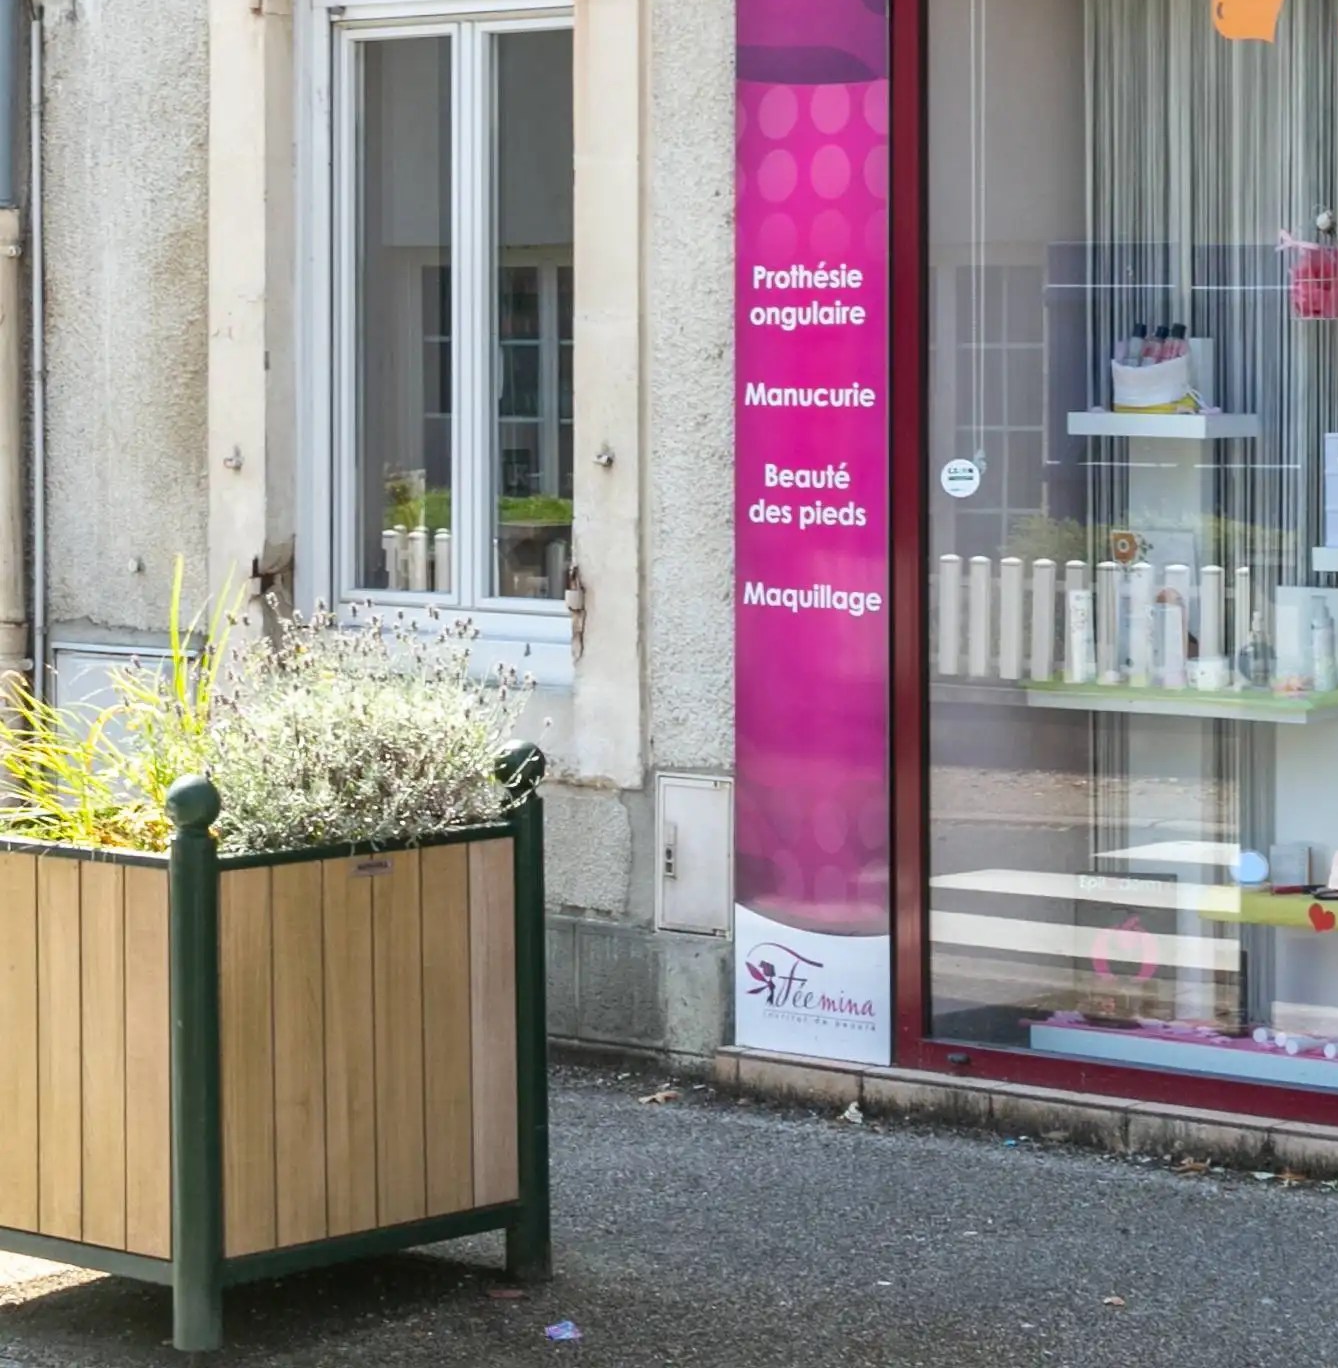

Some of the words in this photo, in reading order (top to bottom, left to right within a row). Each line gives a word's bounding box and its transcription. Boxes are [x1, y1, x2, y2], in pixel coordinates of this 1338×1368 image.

[752, 262, 863, 289] Prothésie
[750, 301, 866, 330] ongulaire
[745, 382, 876, 407] Manucurie
[764, 463, 850, 489] Beauté
[749, 499, 792, 524] des
[798, 501, 867, 530] pieds
[744, 582, 882, 616] Maquillage
[747, 942, 876, 1017] Féemina
